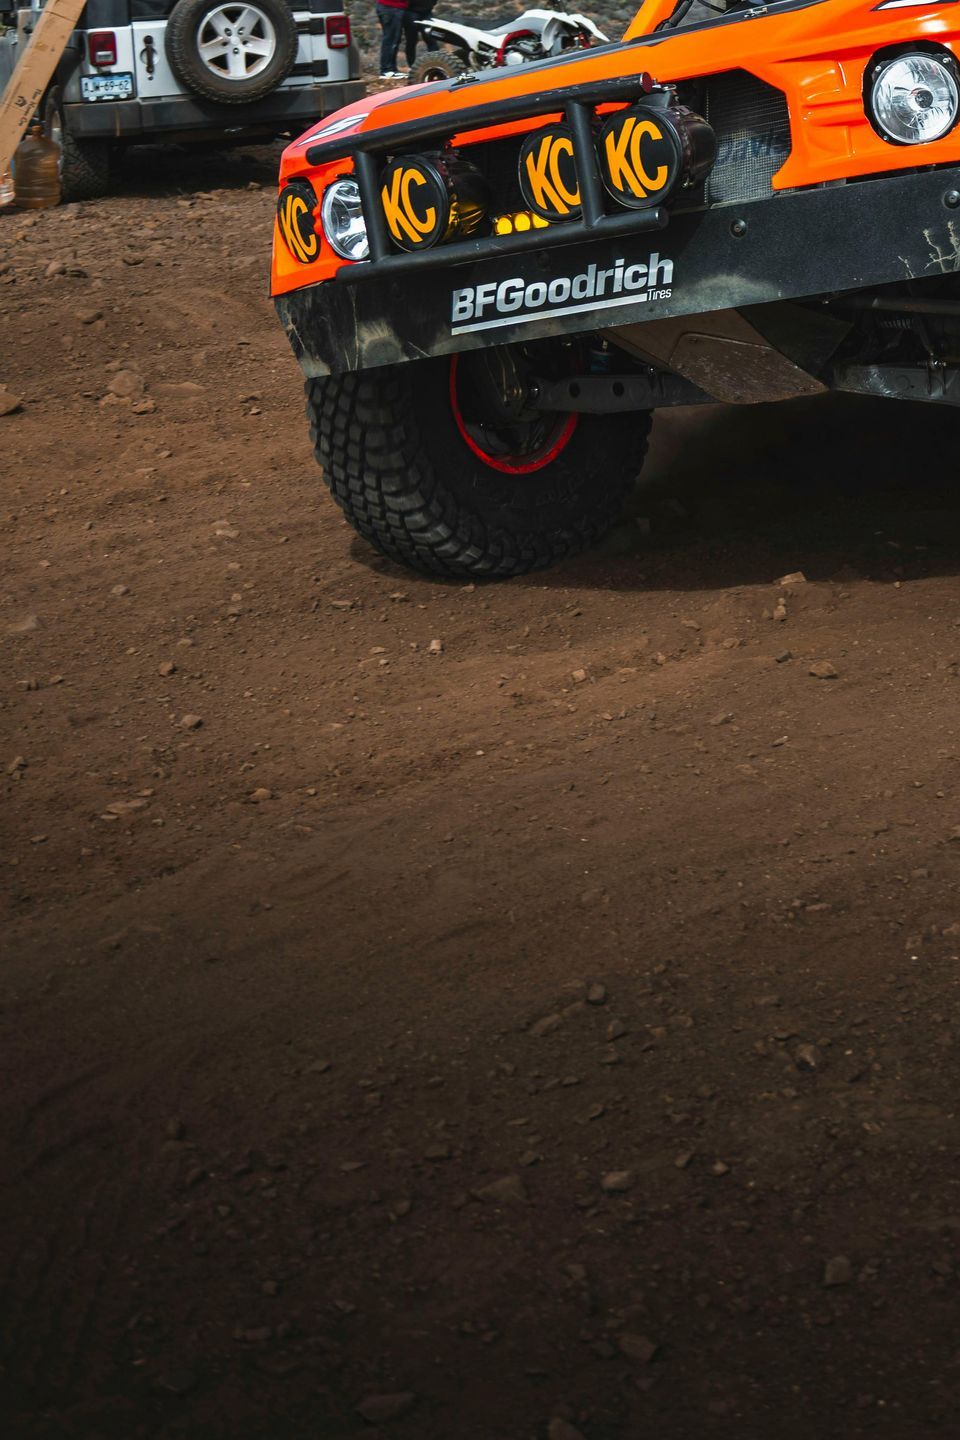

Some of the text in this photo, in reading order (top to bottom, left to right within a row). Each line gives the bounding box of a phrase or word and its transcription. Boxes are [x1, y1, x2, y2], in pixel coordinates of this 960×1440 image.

[525, 135, 582, 215] KC
[605, 117, 668, 199] KC
[280, 194, 317, 263] KC
[381, 167, 437, 243] KC
[451, 252, 674, 323] BFGoodrich
[647, 288, 672, 302] Tires
